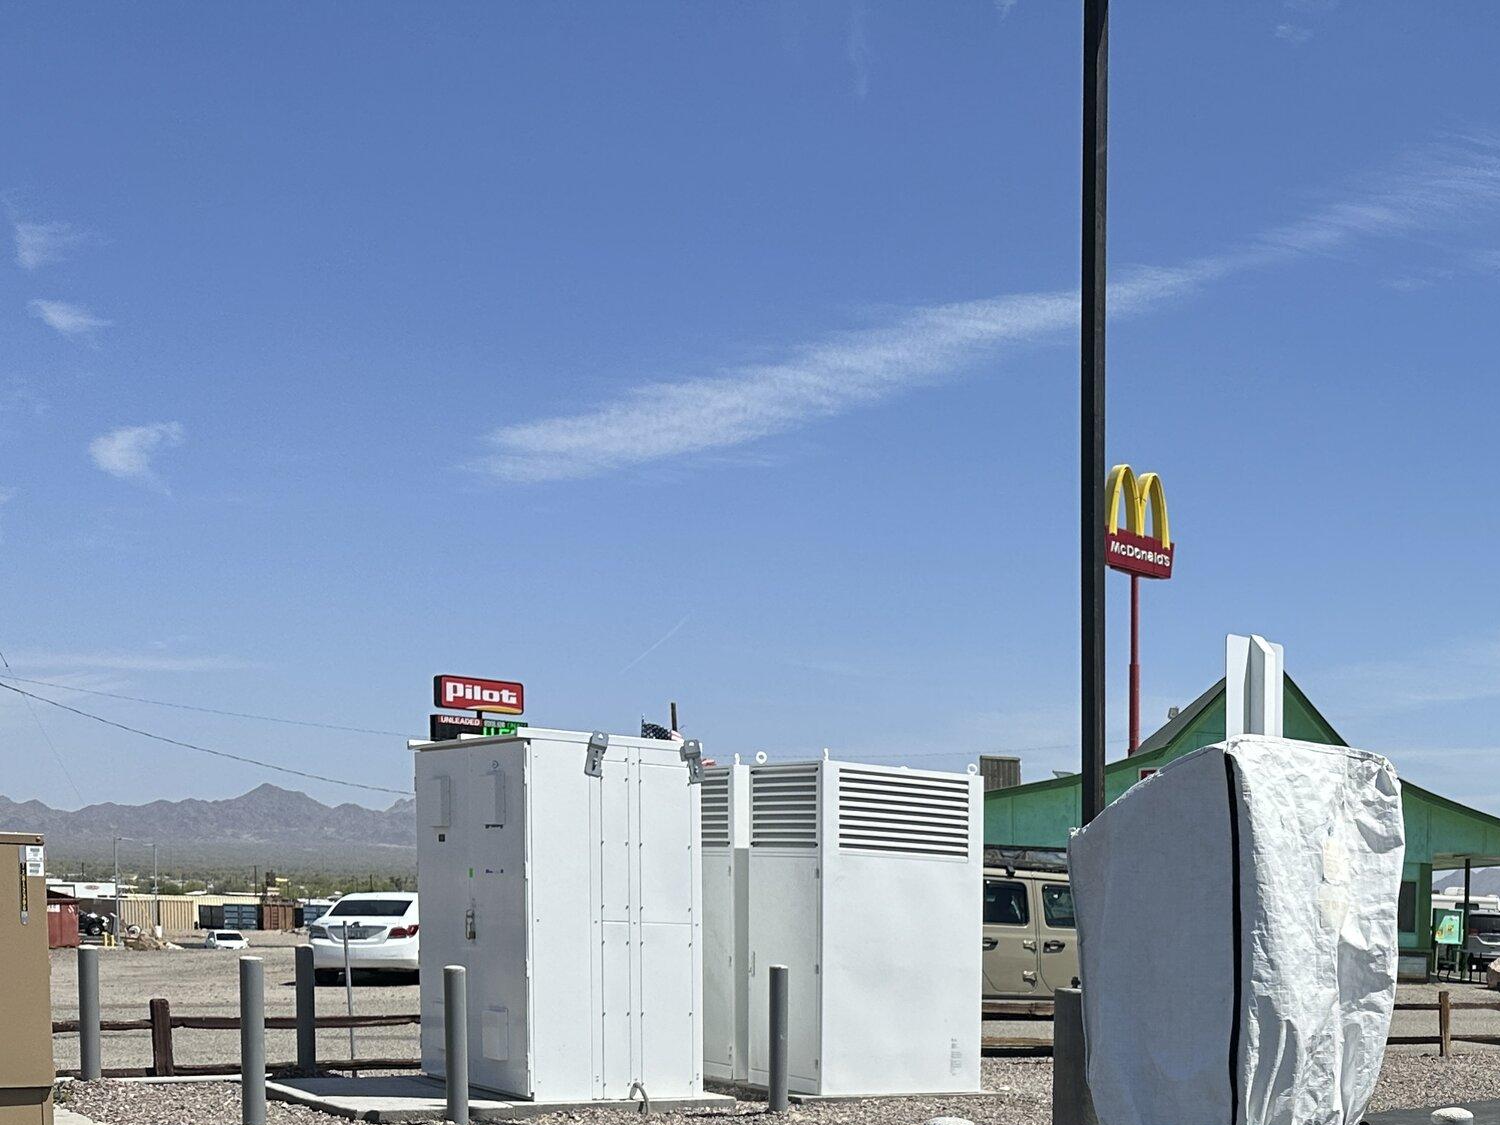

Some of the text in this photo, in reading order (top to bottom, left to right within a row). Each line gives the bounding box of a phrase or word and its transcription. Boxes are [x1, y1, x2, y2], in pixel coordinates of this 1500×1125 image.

[1110, 540, 1171, 567] McDonald's
[445, 682, 517, 704] Pilot
[440, 716, 480, 726] UNLEADED
